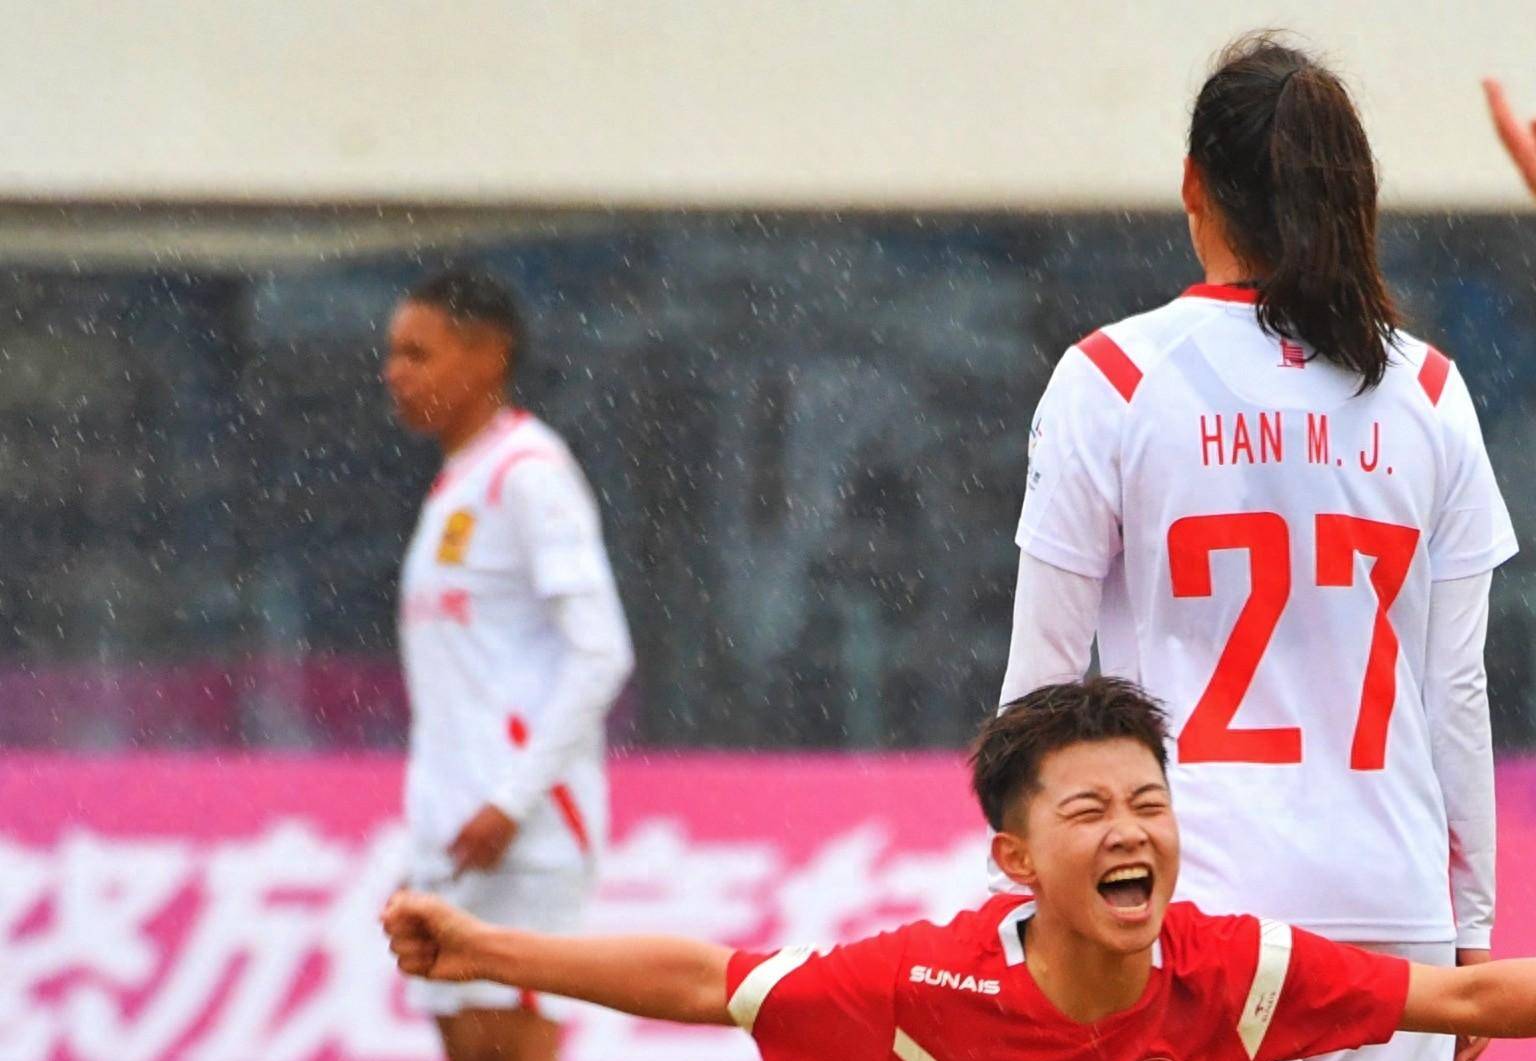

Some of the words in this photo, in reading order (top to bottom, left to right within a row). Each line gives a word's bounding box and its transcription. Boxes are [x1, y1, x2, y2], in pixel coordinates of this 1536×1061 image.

[1200, 411, 1282, 466] HAN
[1307, 414, 1343, 468] M.
[1360, 421, 1394, 475] J.
[1167, 511, 1421, 771] 27
[909, 965, 1001, 995] SUNAIS
